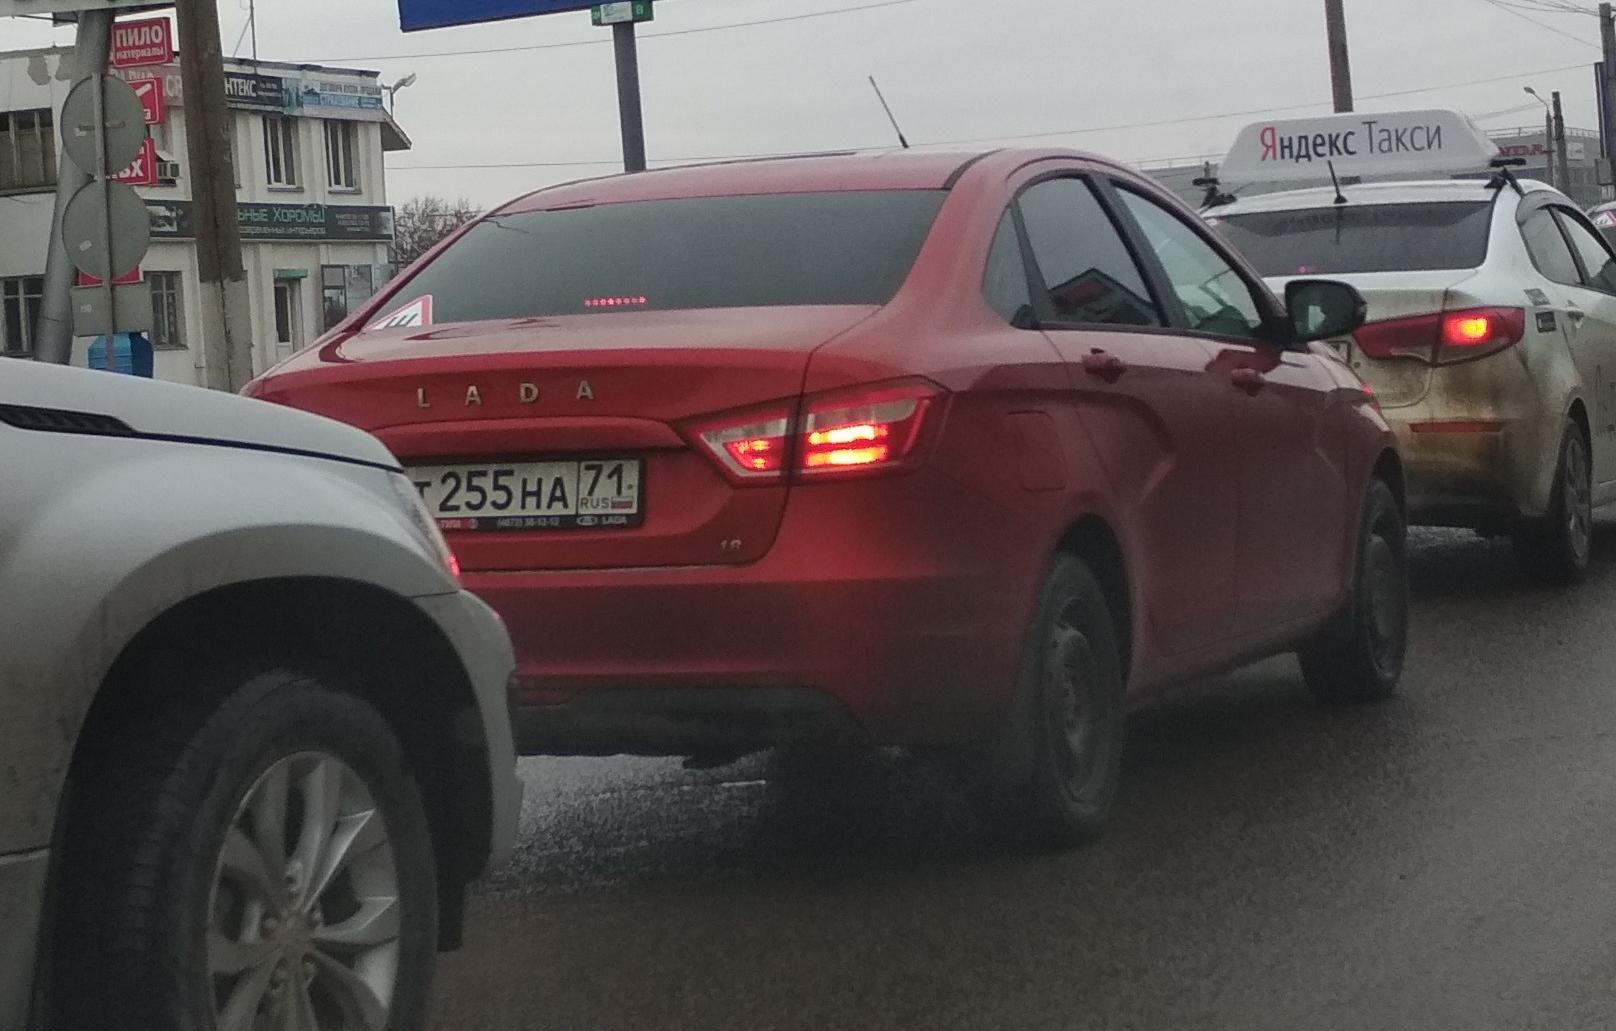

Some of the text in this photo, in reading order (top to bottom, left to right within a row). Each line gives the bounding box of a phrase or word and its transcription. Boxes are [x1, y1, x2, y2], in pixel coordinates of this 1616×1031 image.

[115, 26, 163, 47] ПИЛО
[116, 47, 164, 61] материалы
[1260, 120, 1442, 163] Яндекс Такси
[417, 380, 594, 408] LADA
[584, 463, 624, 497] 71
[580, 497, 610, 509] RUS
